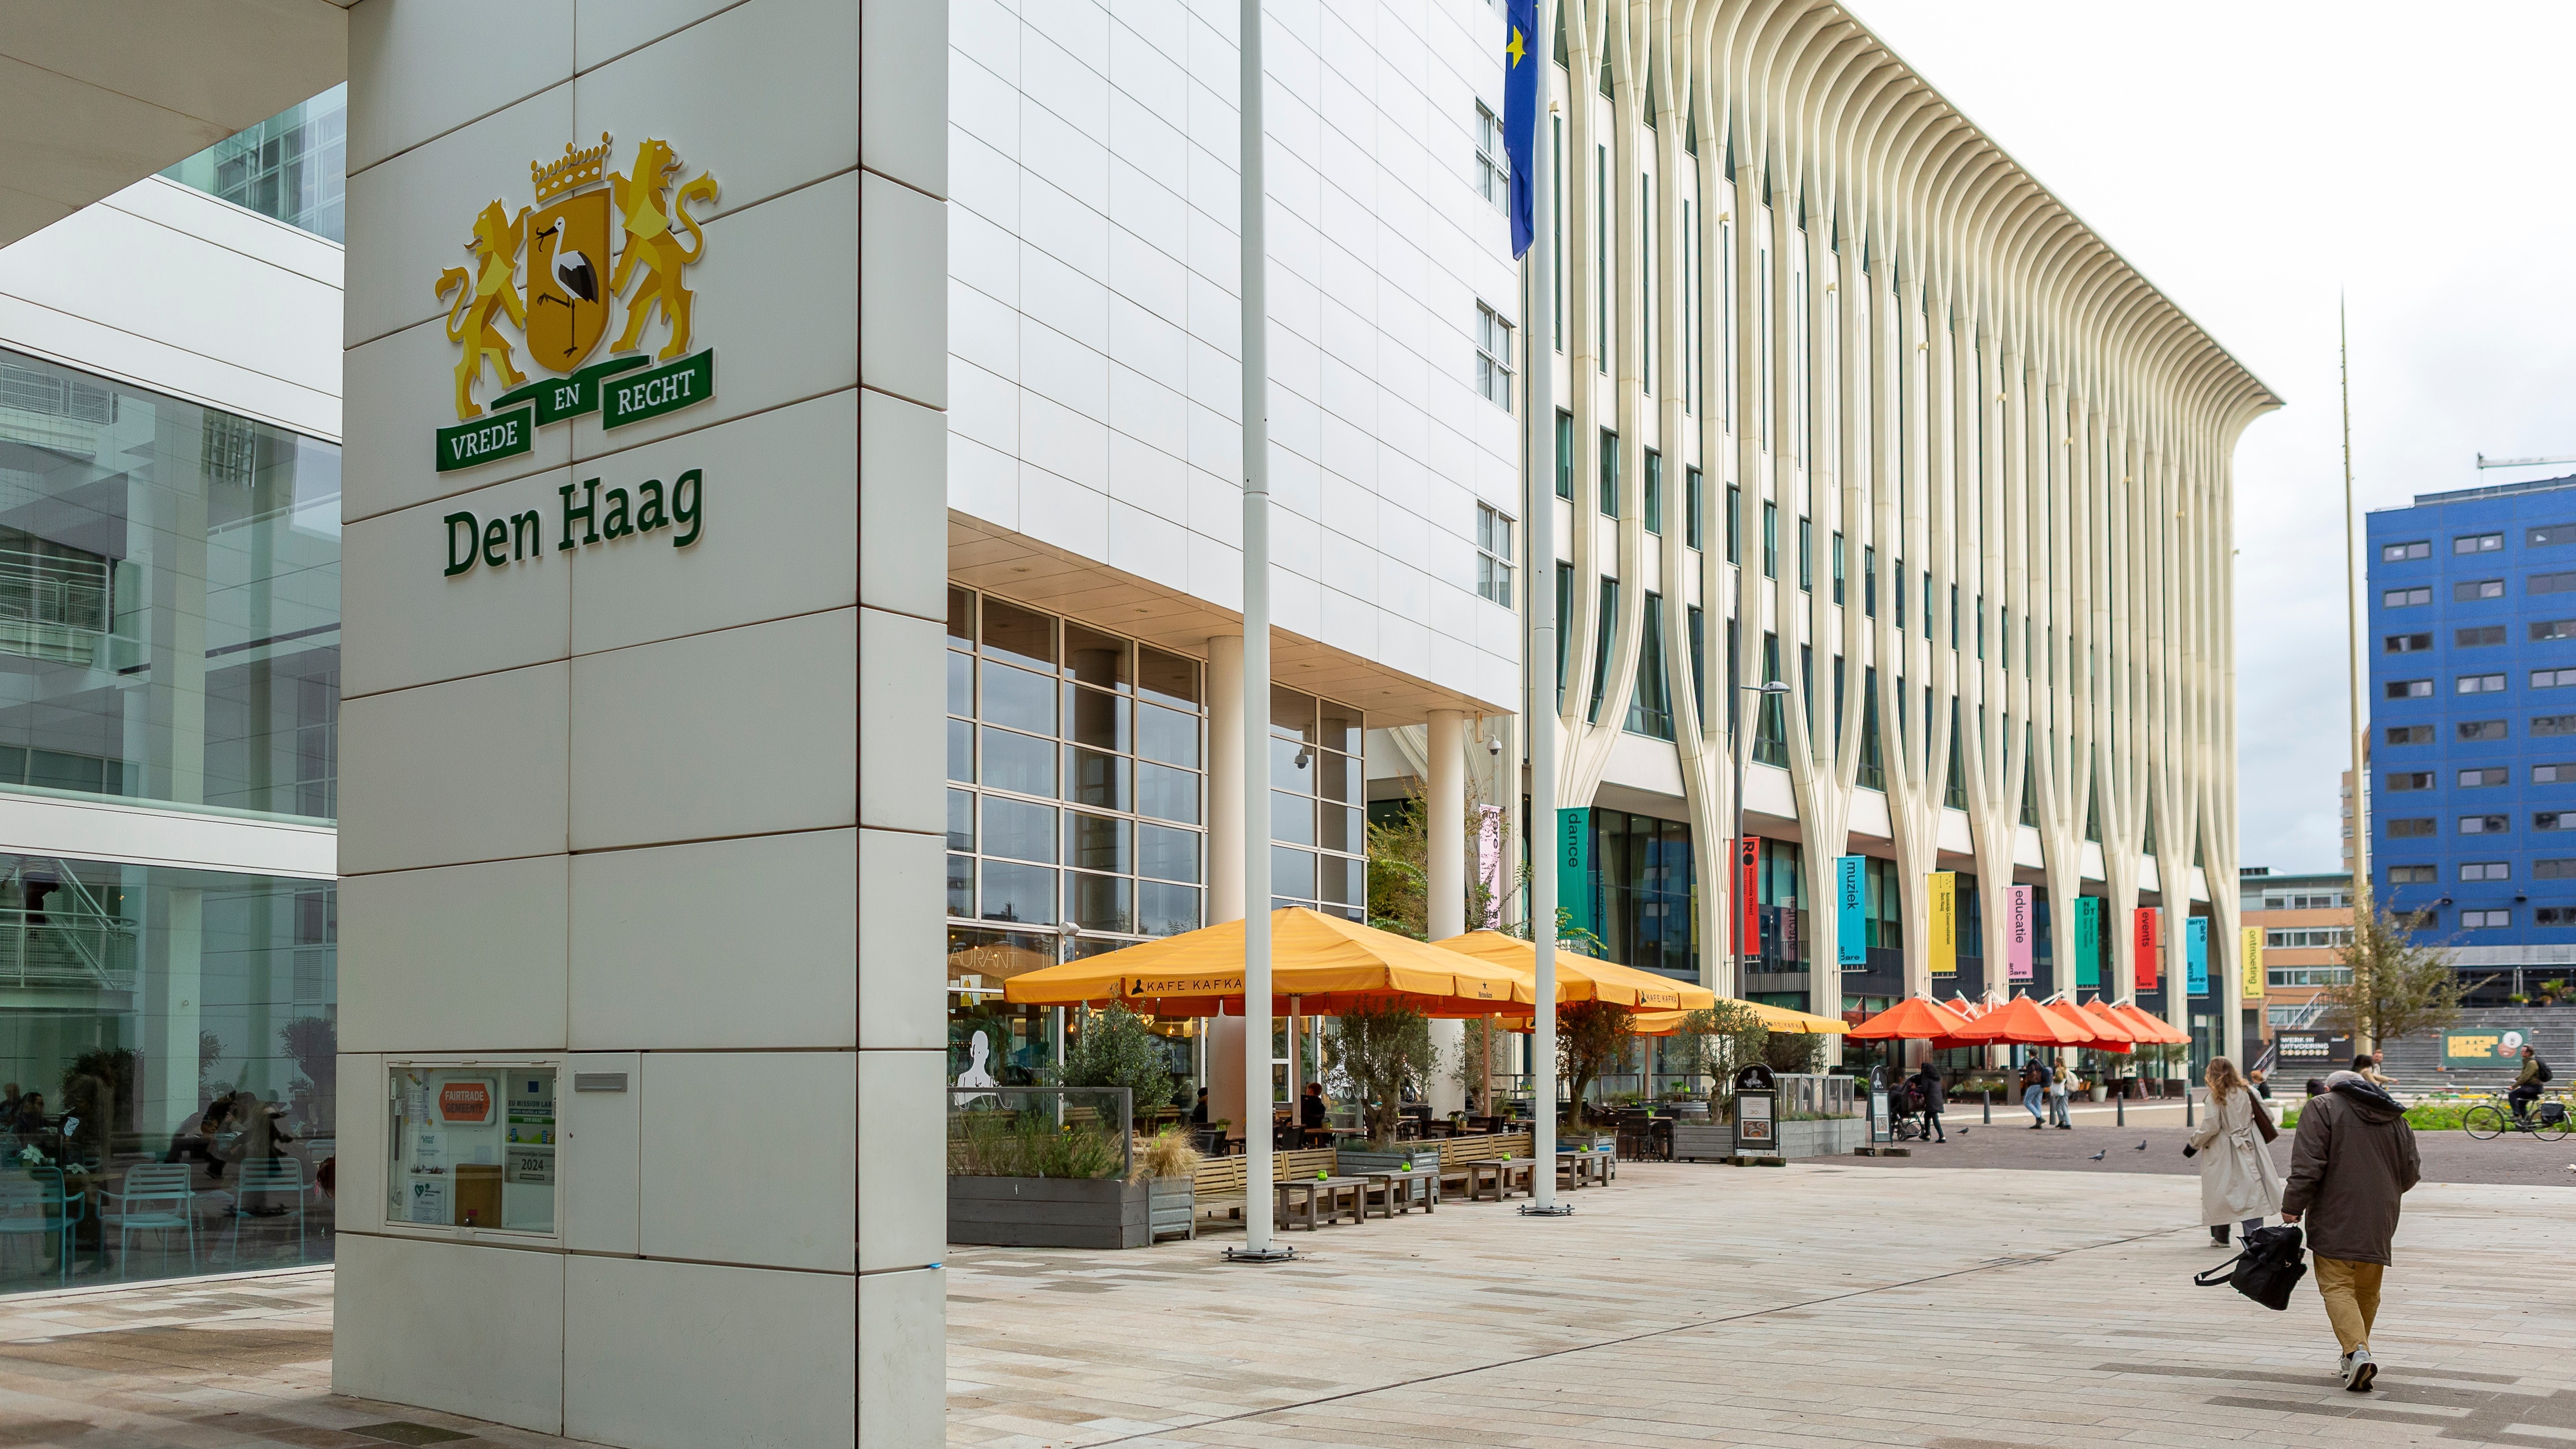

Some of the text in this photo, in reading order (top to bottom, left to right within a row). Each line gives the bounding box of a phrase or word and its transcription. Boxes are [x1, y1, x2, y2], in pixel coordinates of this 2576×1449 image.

[555, 384, 580, 411] EN
[618, 369, 695, 415] RECHT
[451, 421, 517, 459] VREDE
[444, 468, 703, 577] Den Haag
[1568, 813, 1581, 868] dance
[1847, 862, 1859, 910] muziek
[2016, 890, 2026, 943] educatie
[2142, 912, 2150, 947] events
[2249, 930, 2258, 984] ontmoeting
[1147, 979, 1242, 991] KAFE KAFKA
[1647, 994, 1678, 1004] KAFE KAFKA
[445, 1091, 484, 1101] FAIRTRADE
[446, 1103, 483, 1113] GEMEENTE
[521, 1159, 543, 1170] 2024
